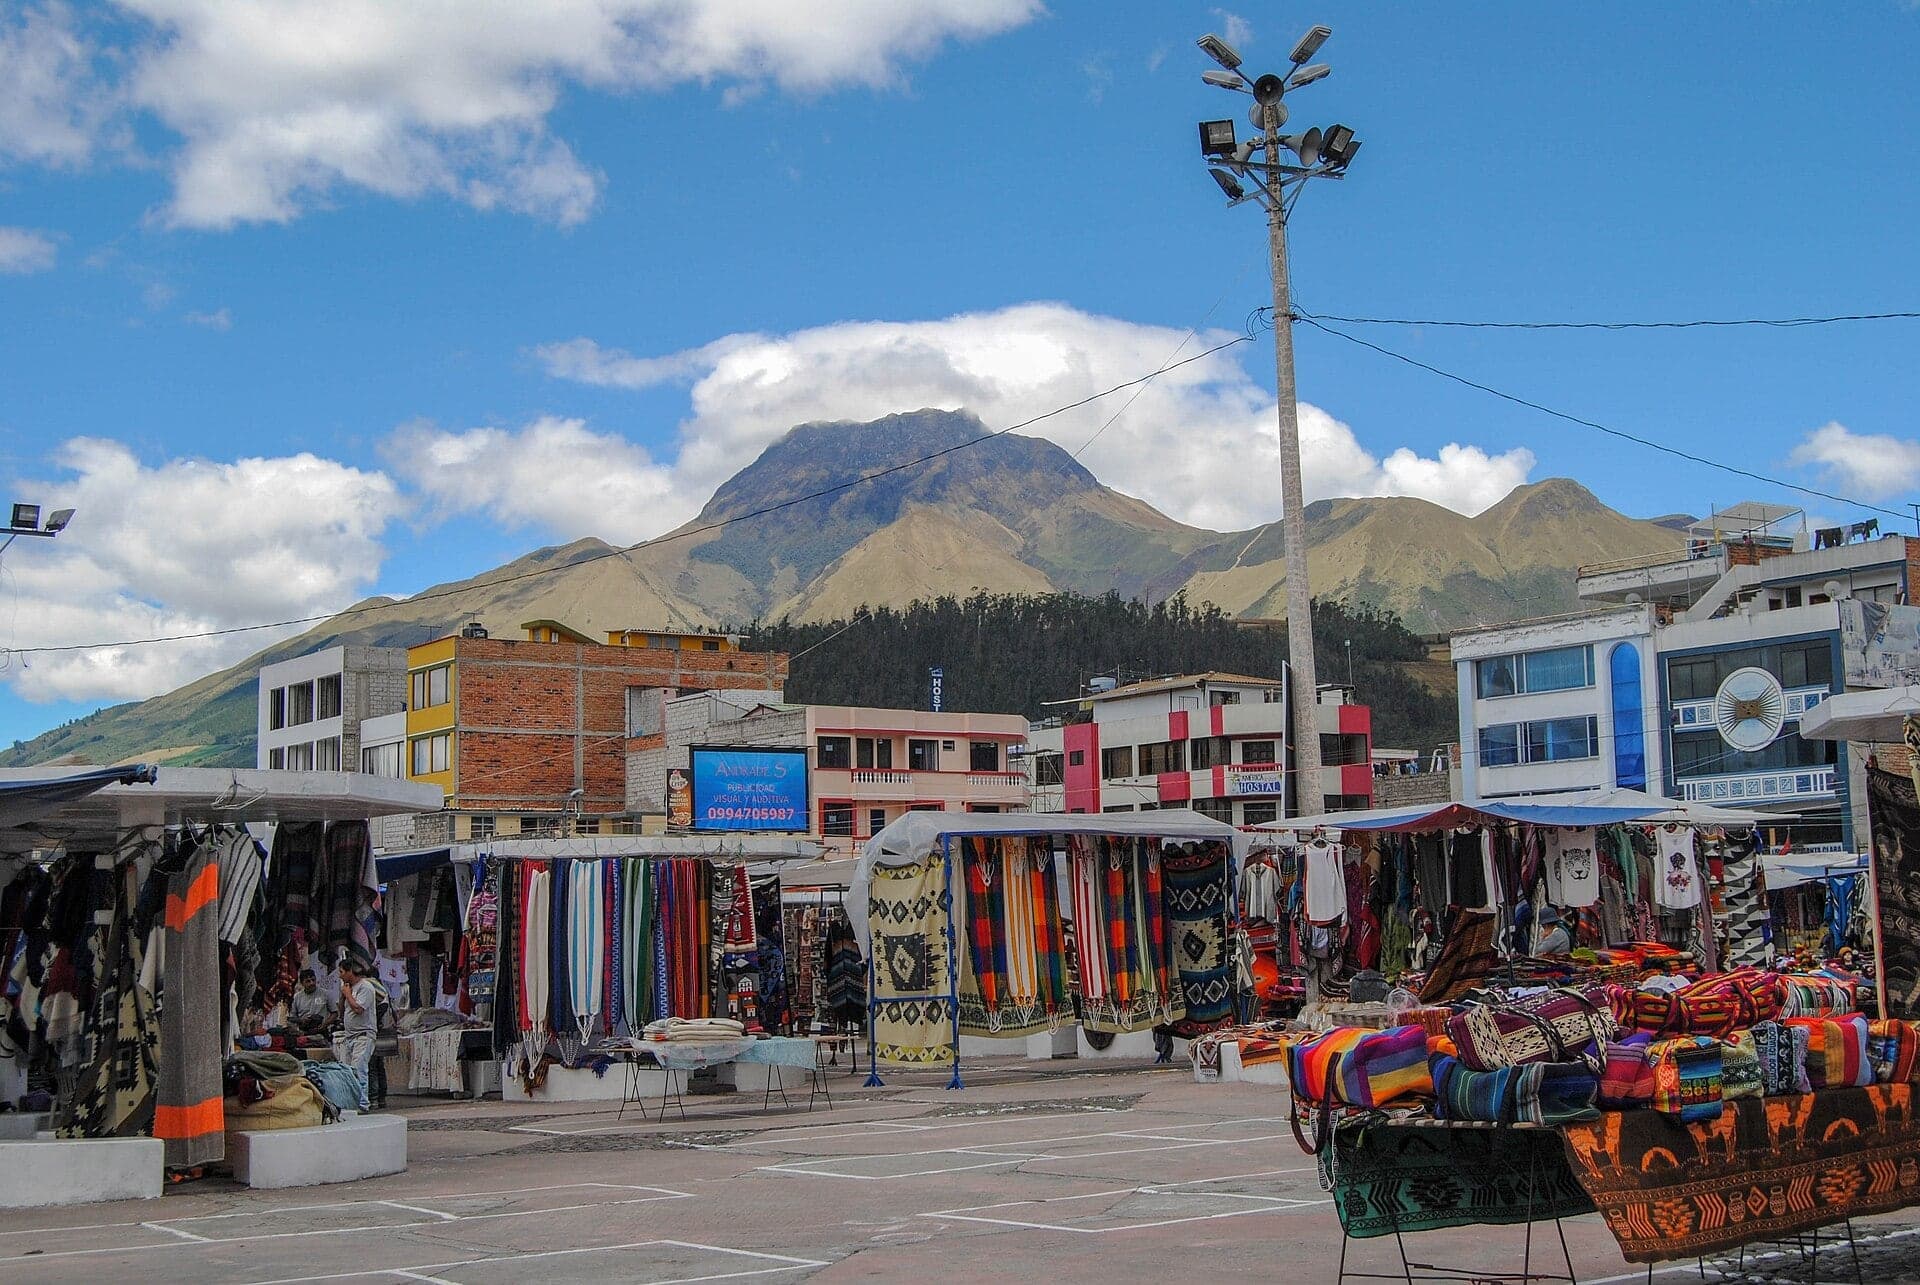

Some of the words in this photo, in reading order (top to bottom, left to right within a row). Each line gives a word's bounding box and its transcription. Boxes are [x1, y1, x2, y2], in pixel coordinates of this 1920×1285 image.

[774, 762, 787, 778] S
[727, 783, 775, 792] PUBLICIDAD
[1240, 782, 1278, 792] HOSTAL
[713, 795, 742, 803] VISUAL
[744, 795, 750, 803] Y
[751, 795, 789, 804] AUDITIVA
[708, 807, 794, 820] 0994705987
[1769, 1026, 1777, 1056] ECUADOR
